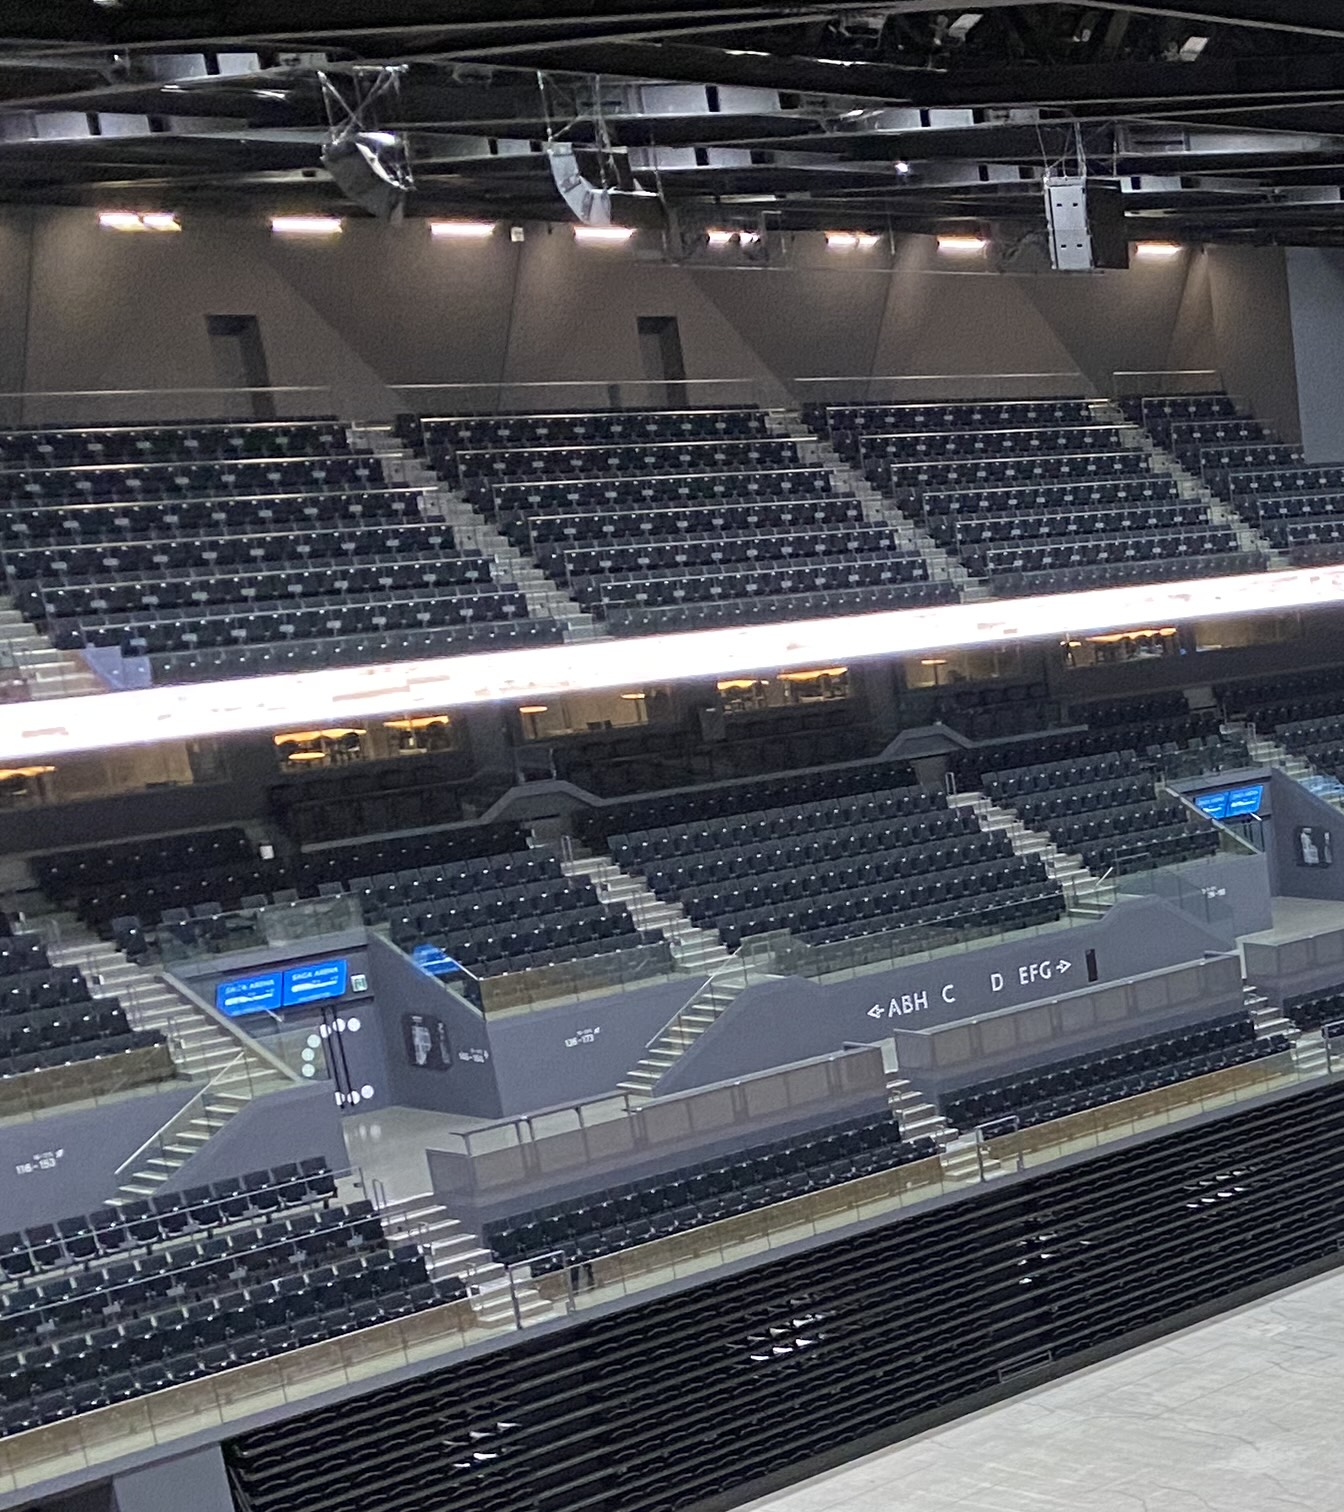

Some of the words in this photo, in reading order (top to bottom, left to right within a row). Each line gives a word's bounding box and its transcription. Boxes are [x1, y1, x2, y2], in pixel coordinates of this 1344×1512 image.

[888, 990, 928, 1018] ABH
[941, 984, 956, 1003] C
[990, 973, 1004, 992] D
[1018, 960, 1052, 985] EFG
